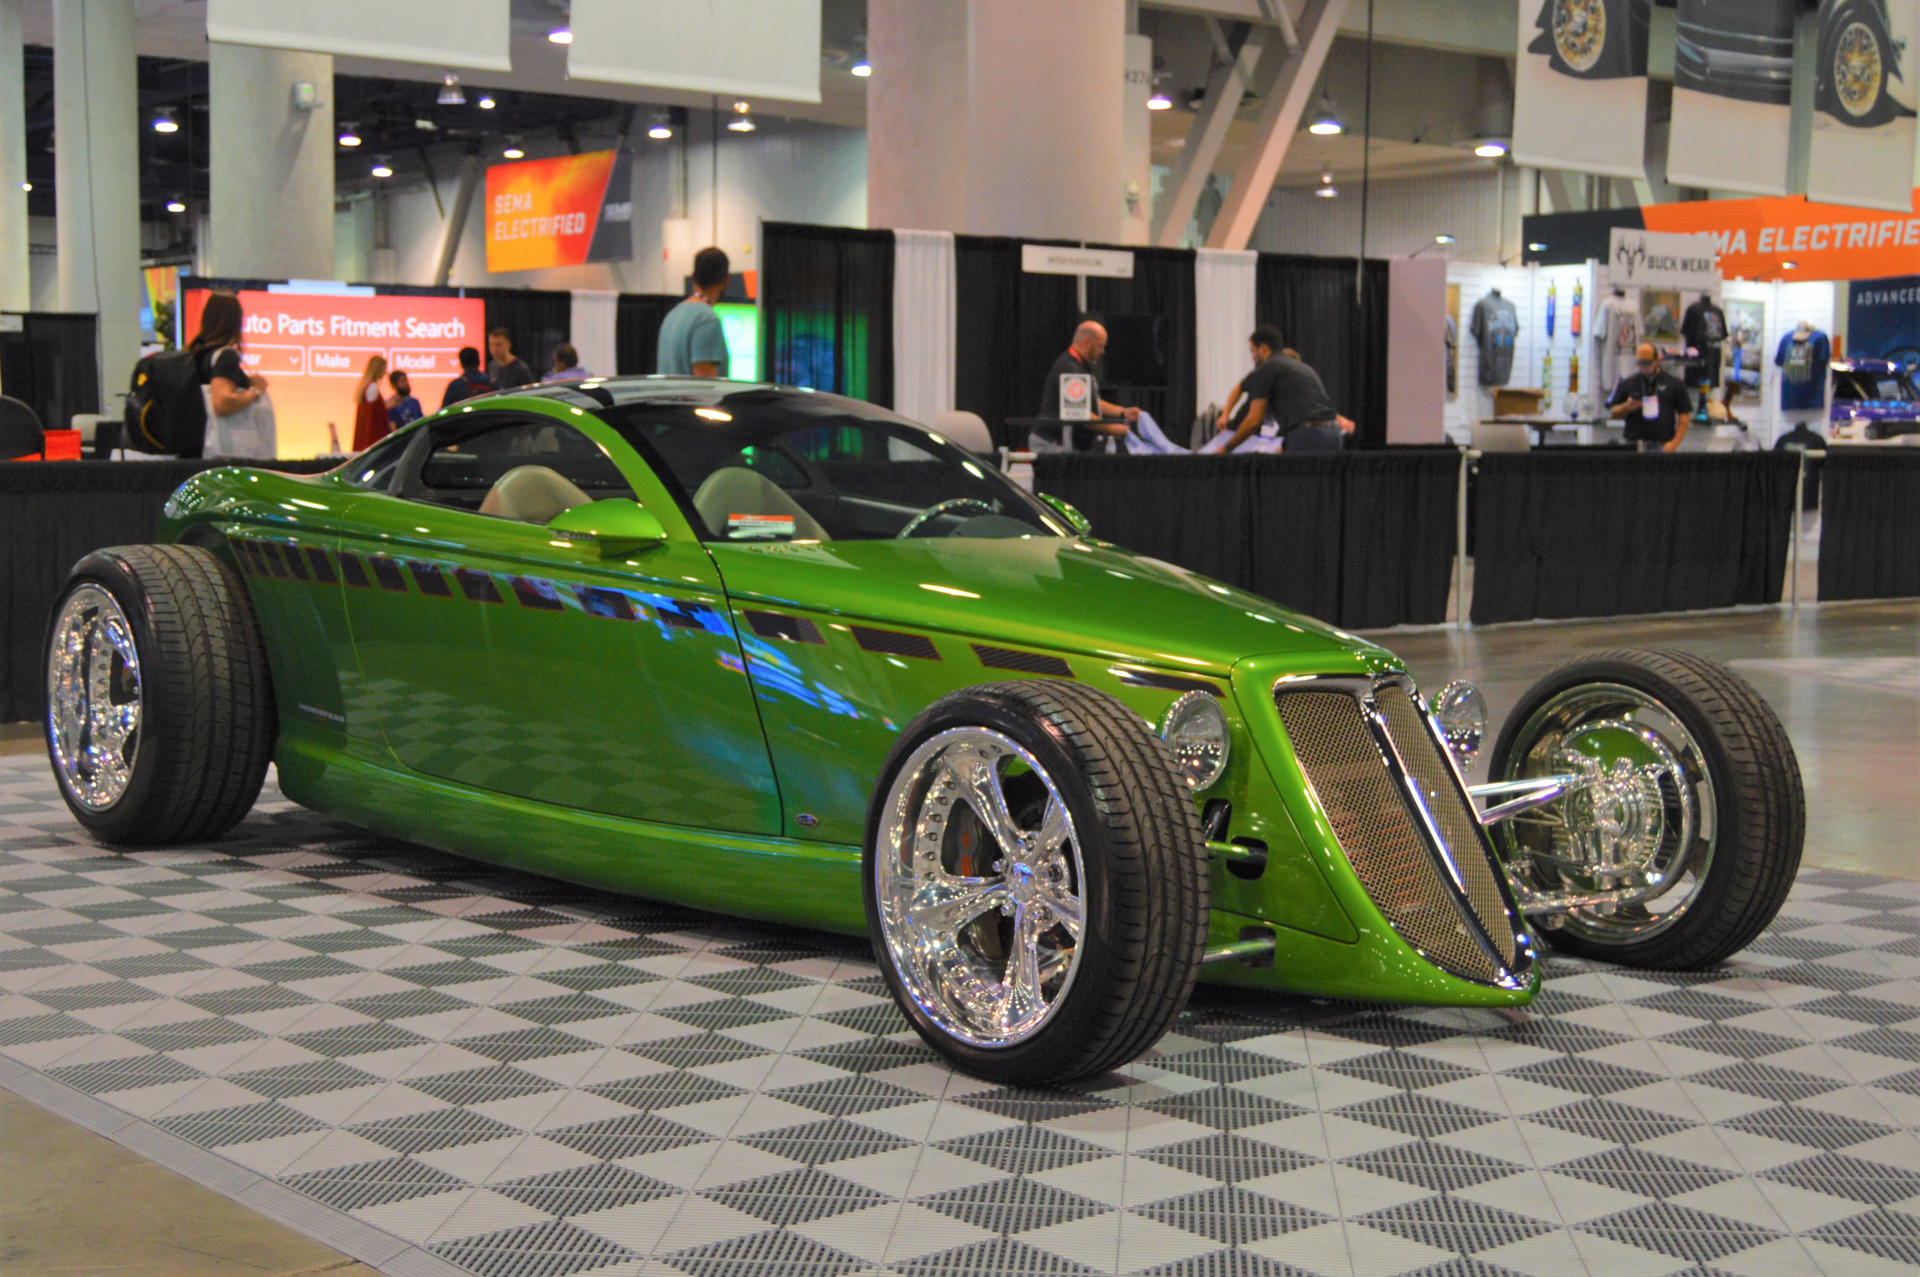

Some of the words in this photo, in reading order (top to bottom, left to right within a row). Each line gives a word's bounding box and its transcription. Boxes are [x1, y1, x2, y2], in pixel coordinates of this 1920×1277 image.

[494, 191, 533, 215] SEMA
[494, 211, 587, 241] ELECTRIFIED
[1692, 228, 1748, 255] MA
[1647, 255, 1678, 271] BUCK
[1680, 257, 1711, 273] WEAR
[241, 314, 272, 335] uto
[277, 314, 325, 336] Parts
[330, 315, 401, 337] Fitment
[405, 317, 465, 339] Search
[241, 353, 261, 366] ear
[315, 353, 350, 368] Make
[396, 355, 435, 369] Model
